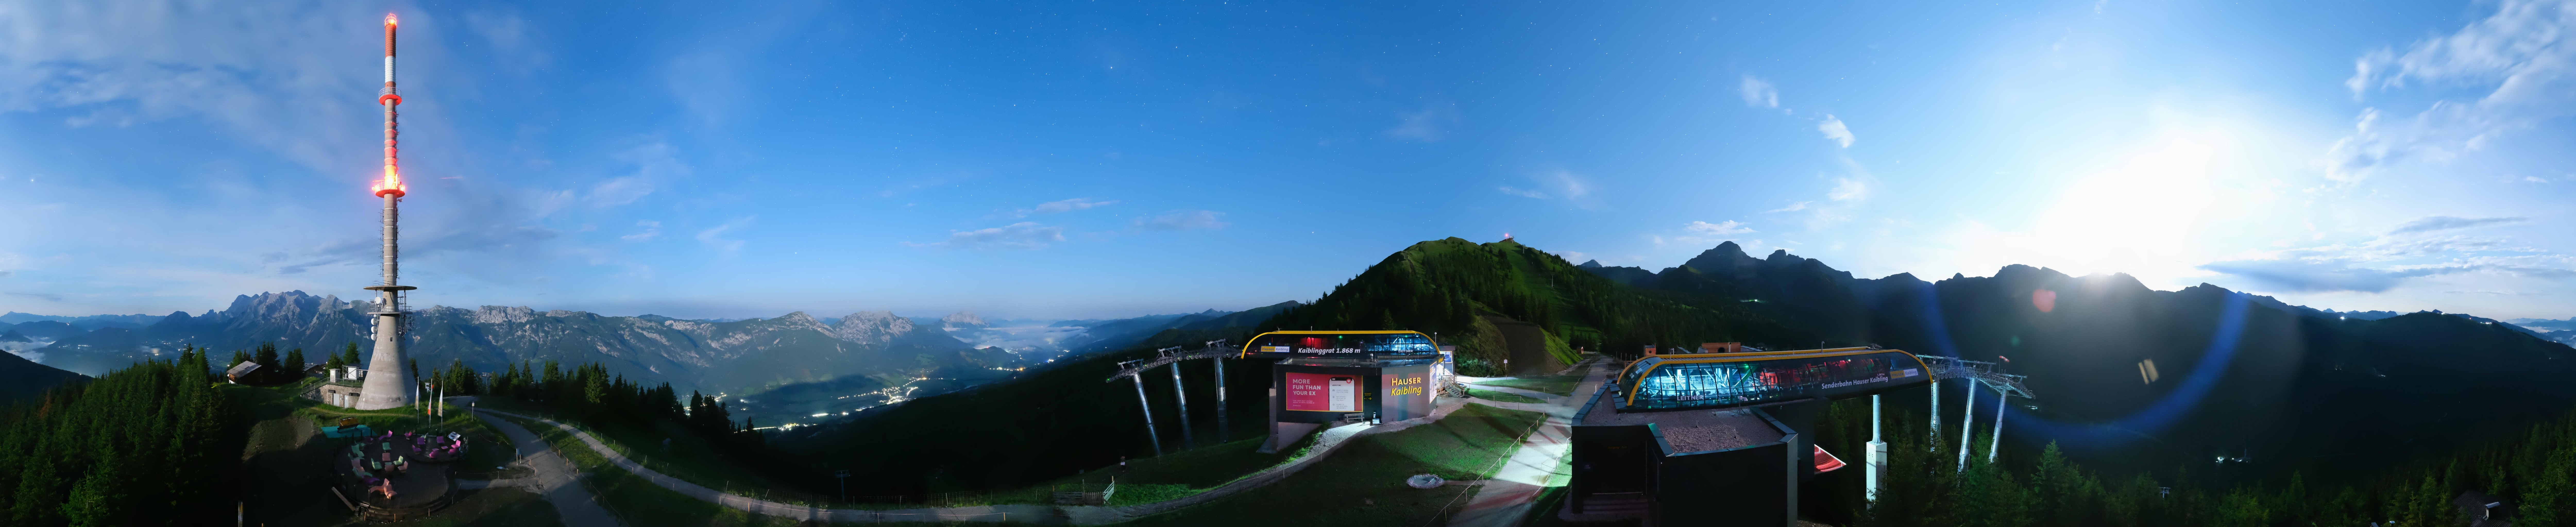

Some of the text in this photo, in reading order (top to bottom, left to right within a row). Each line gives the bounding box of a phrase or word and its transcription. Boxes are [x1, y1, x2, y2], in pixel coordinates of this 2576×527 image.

[1391, 377, 1421, 386] HAUSER
[1822, 380, 1852, 389] Senderbahn
[1391, 386, 1421, 396] Kaibling
